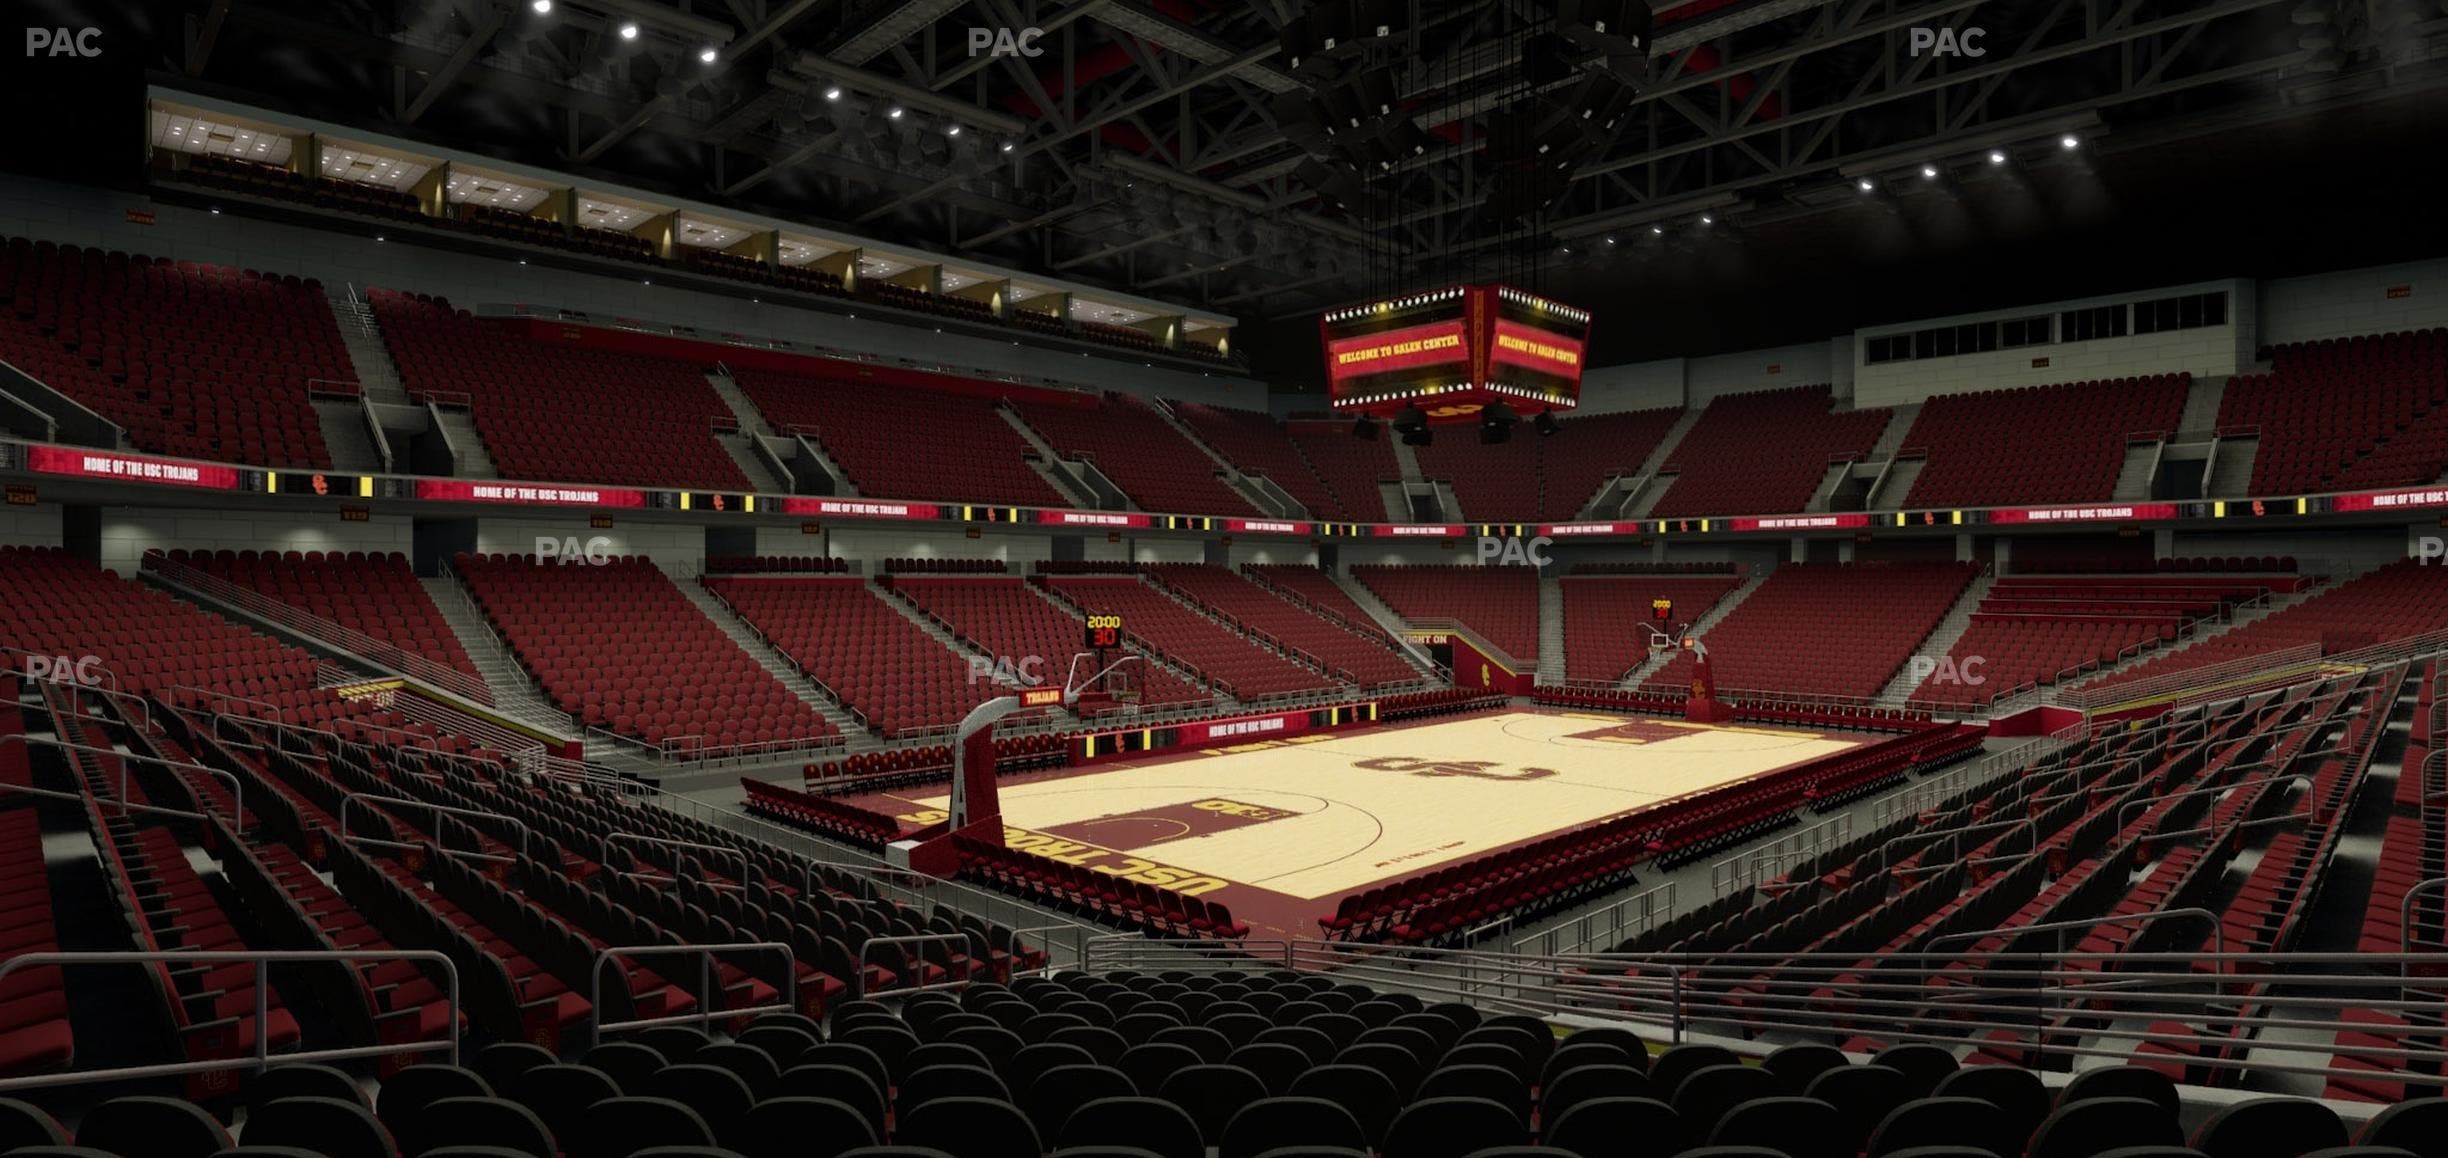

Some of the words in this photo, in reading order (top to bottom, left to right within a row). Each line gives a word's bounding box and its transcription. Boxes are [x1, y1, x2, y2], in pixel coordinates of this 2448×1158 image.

[1339, 347, 1379, 365] WELCOME
[1380, 345, 1392, 358] TO
[1423, 335, 1459, 351] CENTER
[84, 458, 111, 472] HOME
[112, 460, 125, 473] OF
[126, 461, 142, 475] THE
[144, 464, 161, 477] USC
[163, 466, 198, 480] TROJANS
[473, 487, 502, 497] HOME
[504, 488, 517, 498] OF
[518, 489, 537, 499] THE
[538, 490, 557, 500] USC
[559, 491, 598, 501] TROJANS
[2373, 496, 2396, 505] HOME
[2397, 494, 2408, 504] OF
[2408, 493, 2425, 503] THE
[2426, 492, 2444, 502] USC
[2028, 511, 2051, 519] HOME
[2063, 510, 2078, 518] THE
[2096, 508, 2132, 517] TROJANS
[1087, 615, 1120, 629] 20:00
[1093, 629, 1116, 645] 30
[1433, 635, 1447, 645] ON
[1090, 858, 1230, 897] USC
